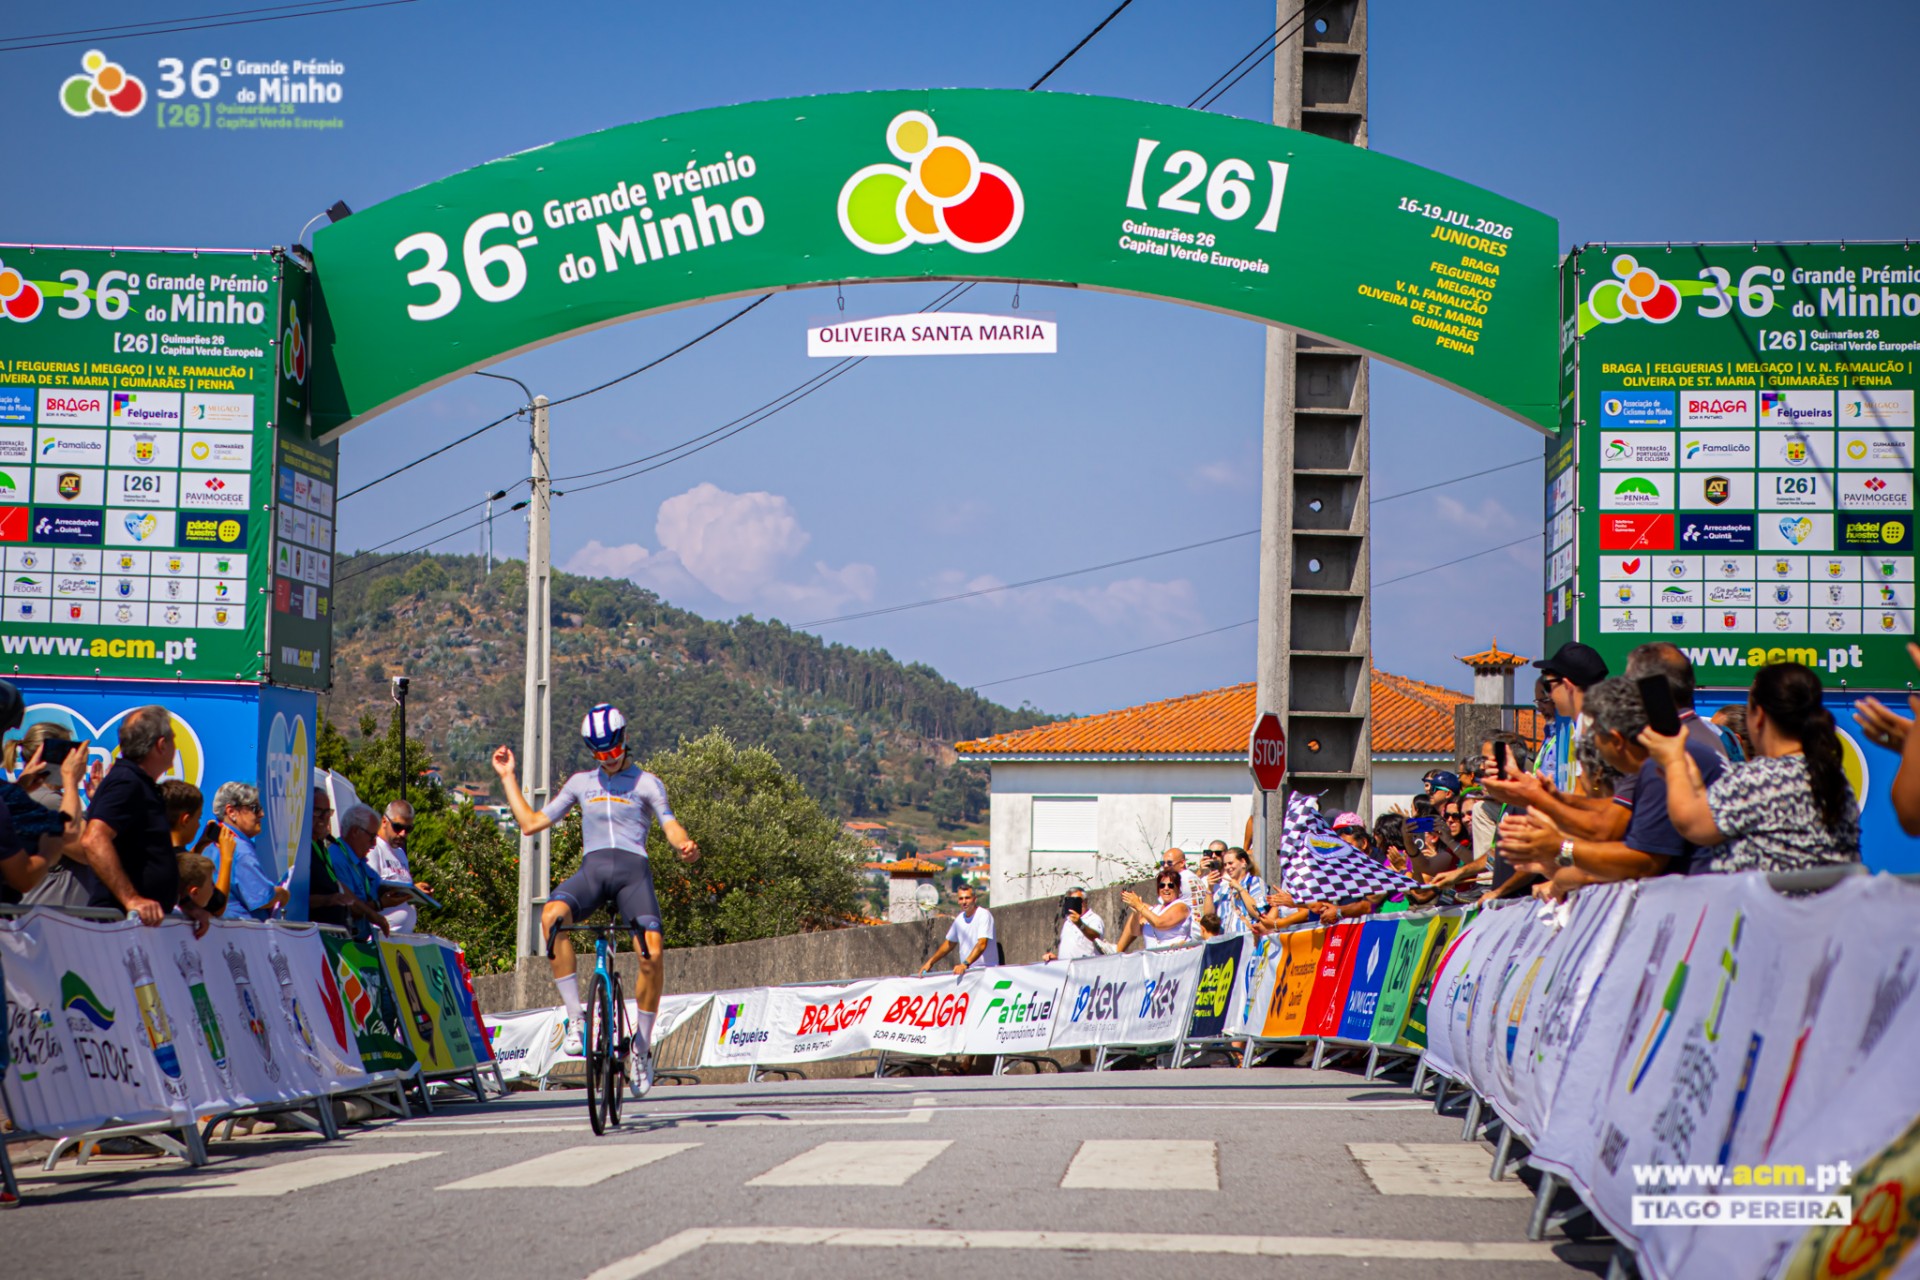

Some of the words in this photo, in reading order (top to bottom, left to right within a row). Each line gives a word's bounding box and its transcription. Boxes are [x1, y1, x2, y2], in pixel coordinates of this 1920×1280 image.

[543, 181, 647, 229] Grande
[653, 151, 757, 200] Prémio
[1398, 196, 1513, 240] 16-19.JUL.2026
[558, 253, 597, 284] do
[596, 195, 765, 273] Minho
[1122, 219, 1194, 245] Guimarães
[1195, 232, 1216, 248] 26
[1431, 225, 1508, 257] JUNIORES
[1119, 235, 1168, 256] Capital
[1170, 244, 1209, 263] Verde
[1210, 251, 1270, 274] Europeia
[394, 210, 539, 321] 36º
[1430, 261, 1497, 289] FELGUEIRAS
[1461, 255, 1500, 276] BRAGA
[146, 273, 205, 291] Grande
[210, 273, 268, 294] Prémio
[1792, 267, 1856, 285] Grande
[58, 269, 140, 320] 36º
[1396, 280, 1406, 292] V.
[1408, 284, 1420, 296] N.
[1422, 288, 1488, 315] FAMALICÃO
[1436, 278, 1493, 302] MELGAÇO
[1697, 265, 1785, 318] 36º
[145, 305, 167, 322] do
[170, 292, 265, 325] Minho
[1357, 284, 1408, 307] OLIVEIRA
[1410, 299, 1427, 312] DE
[1427, 303, 1442, 317] ST.
[1445, 309, 1483, 329] MARIA
[1792, 300, 1816, 317] do
[1819, 286, 1920, 317] Minho
[819, 327, 906, 343] OLIVEIRA
[911, 325, 974, 342] SANTA
[979, 324, 1045, 341] MARIA
[1412, 314, 1480, 342] GUIMARÃES
[1810, 329, 1864, 340] Guimarães
[1866, 330, 1880, 340] 26
[161, 333, 211, 345] Guimarães
[212, 335, 225, 346] 26
[1436, 335, 1475, 356] PENHA
[1810, 340, 1847, 352] Capital
[1848, 341, 1878, 351] Verde
[1879, 340, 1920, 352] Europeia
[161, 346, 194, 357] Capital
[195, 347, 223, 358] Verde
[225, 348, 263, 360] Europeia
[16, 361, 80, 373] FELGUERIAS
[91, 364, 145, 377] MELGAÇO
[156, 366, 166, 376] V.
[168, 367, 180, 377] N.
[183, 365, 246, 378] FAMALICÃO
[1602, 363, 1642, 374] BRAGA
[1654, 362, 1723, 374] FELGUERIAS
[1735, 362, 1793, 376] MELGAÇO
[1805, 363, 1817, 373] V.
[1819, 362, 1832, 373] N.
[1835, 360, 1904, 373] FAMALICÃO
[38, 375, 52, 385] DE
[55, 376, 69, 386] ST.
[72, 376, 109, 387] MARIA
[120, 377, 186, 389] GUIMARÃES
[197, 380, 235, 390] PENHA
[1623, 376, 1676, 387] OLIVEIRA
[1679, 376, 1694, 387] DE
[1697, 376, 1713, 387] ST.
[1715, 376, 1756, 387] MARIA
[1768, 374, 1839, 386] GUIMARÃES
[1851, 375, 1892, 386] PENHA
[47, 398, 100, 412] BRAGA
[127, 409, 178, 420] Felgueiras
[1688, 399, 1747, 414] BRAGA
[1777, 408, 1832, 419] Felgueiras
[0, 439, 24, 447] EDERAÇÃO
[58, 440, 101, 450] Famalicão
[1702, 443, 1751, 453] Famalicão
[185, 492, 244, 503] PAVIMOGEGE
[1843, 493, 1907, 502] PAVIMOGEGE
[55, 518, 99, 528] Arrecadações
[1703, 524, 1751, 533] Arrecadações
[1847, 522, 1880, 533] pádel
[1708, 532, 1732, 540] Quintã
[13, 585, 42, 593] PEDOME
[1661, 595, 1693, 603] PEDOME
[1, 635, 197, 665] www.acm.pt
[1679, 644, 1862, 673] ww.acm.pt
[1254, 738, 1284, 766] STOP
[882, 991, 970, 1031] BRAGA
[978, 981, 1059, 1028] Fafefuel
[797, 995, 873, 1036] BRAGA
[729, 1029, 769, 1045] Felgueiras
